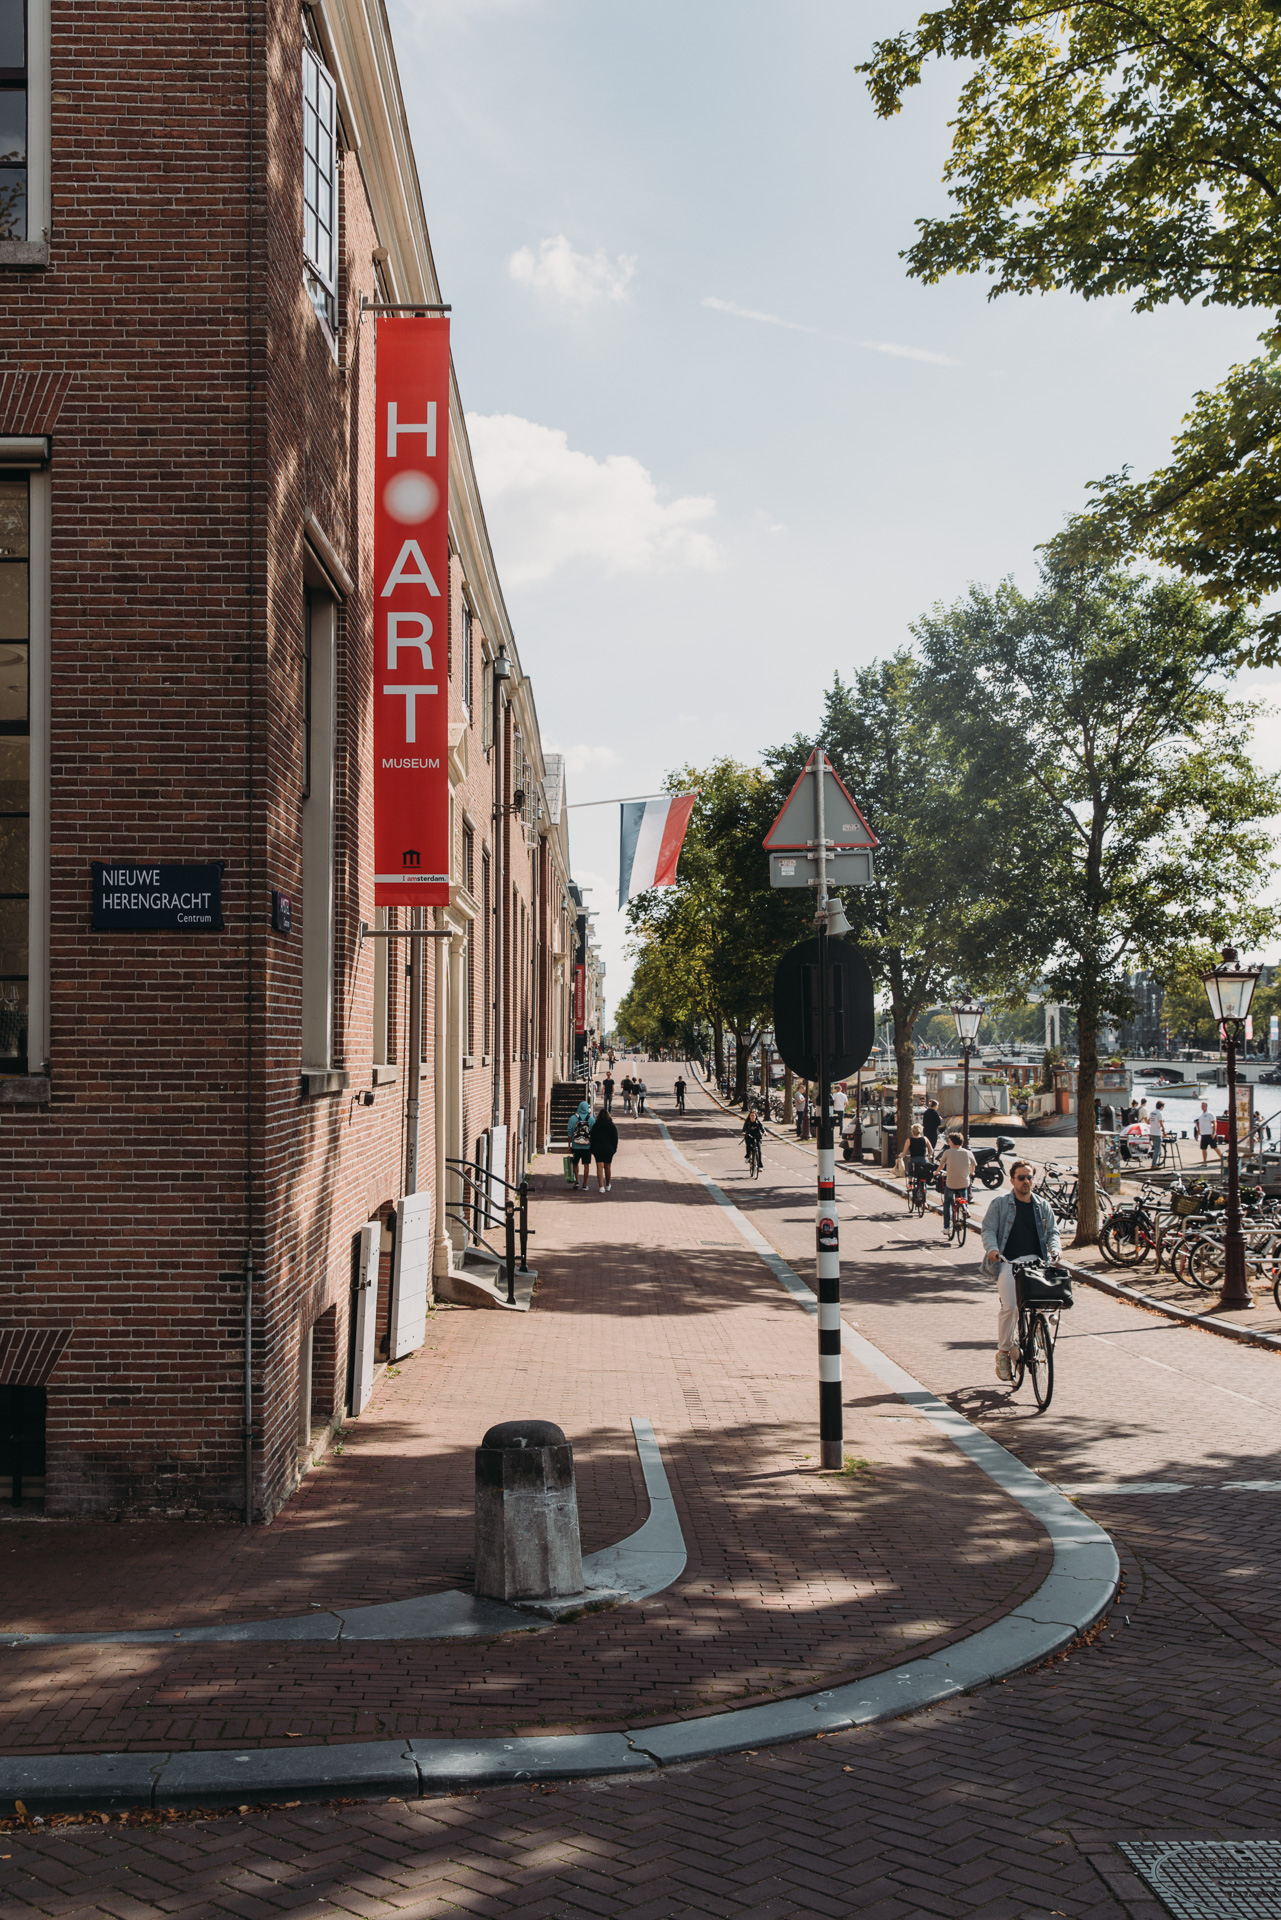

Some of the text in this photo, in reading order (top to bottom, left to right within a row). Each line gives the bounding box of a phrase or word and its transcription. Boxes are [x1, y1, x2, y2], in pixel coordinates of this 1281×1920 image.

[382, 758, 440, 769] MUSEUM
[102, 869, 161, 886] NIEUWE
[102, 893, 212, 909] HERENGRACHT
[177, 912, 212, 924] Centrum
